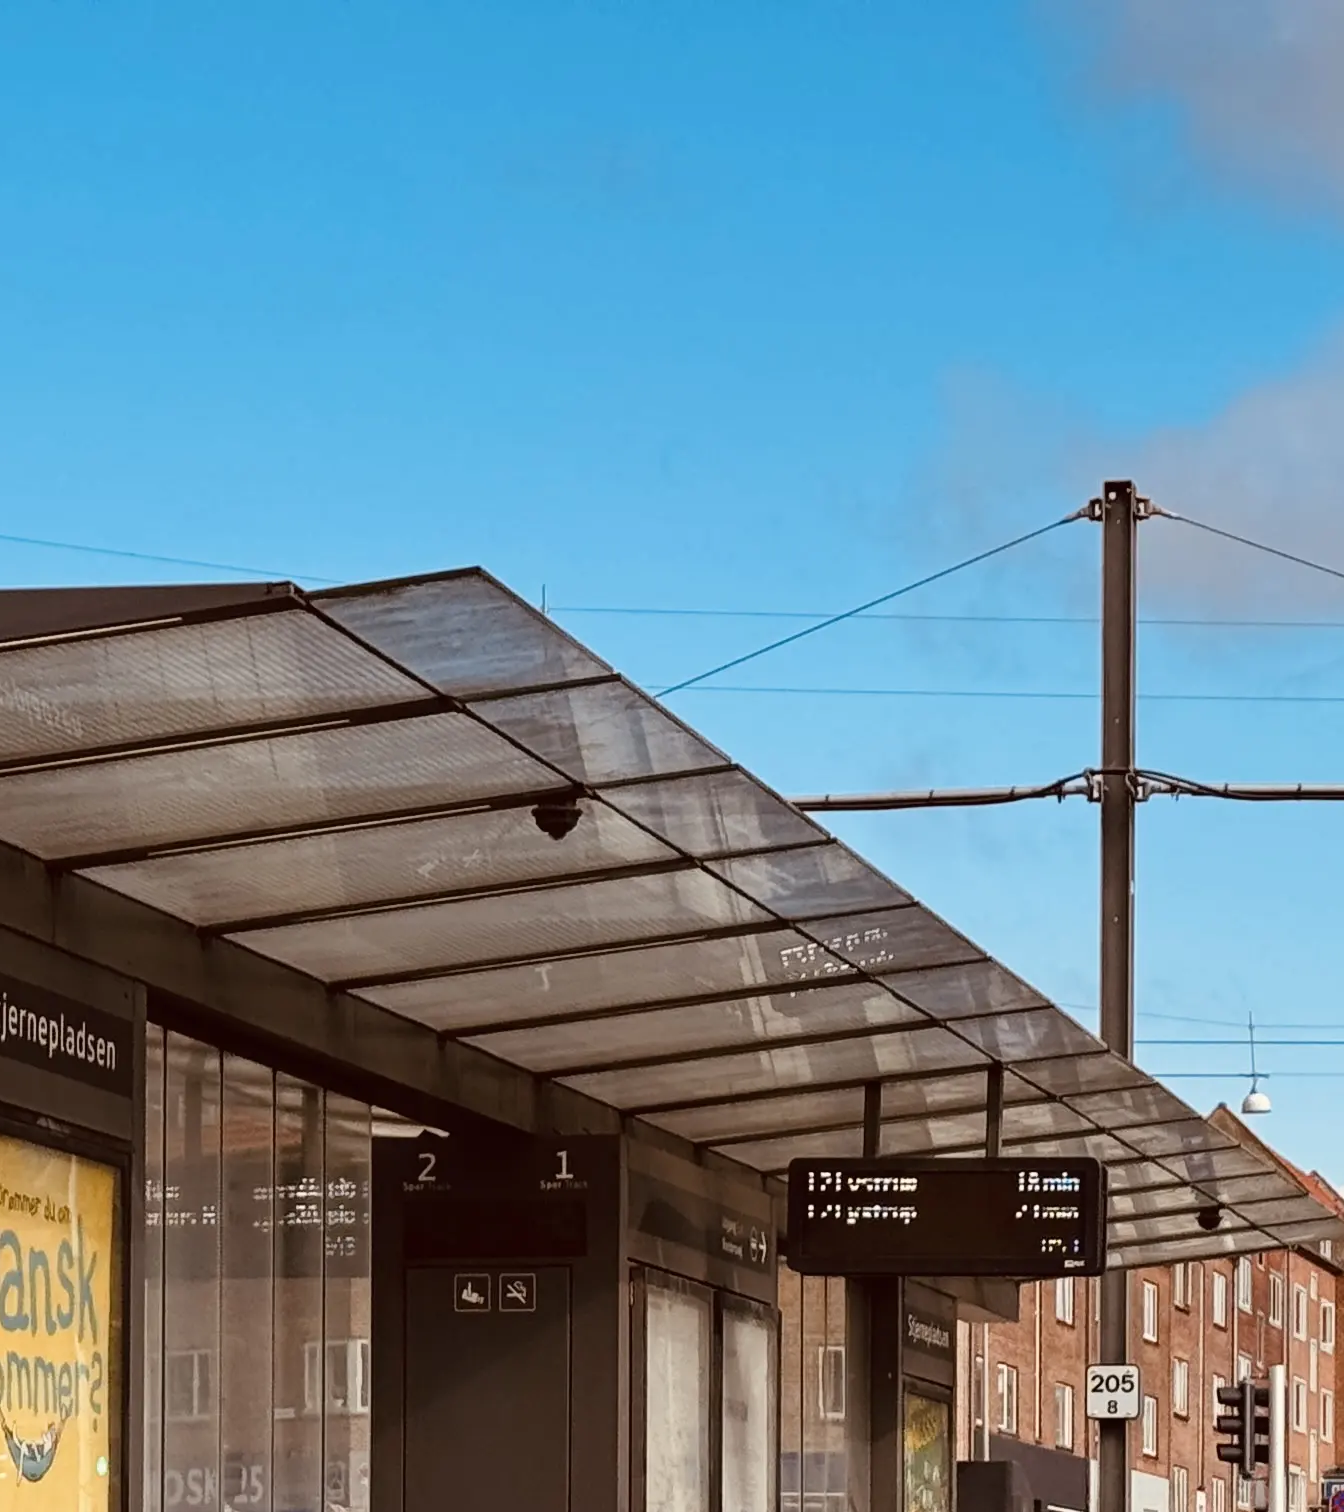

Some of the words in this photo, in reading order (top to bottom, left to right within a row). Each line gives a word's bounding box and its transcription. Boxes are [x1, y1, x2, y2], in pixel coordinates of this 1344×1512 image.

[417, 1153, 437, 1182] 2
[555, 1150, 574, 1179] 1
[1090, 1373, 1135, 1394] 205
[1107, 1399, 1118, 1415] 8
